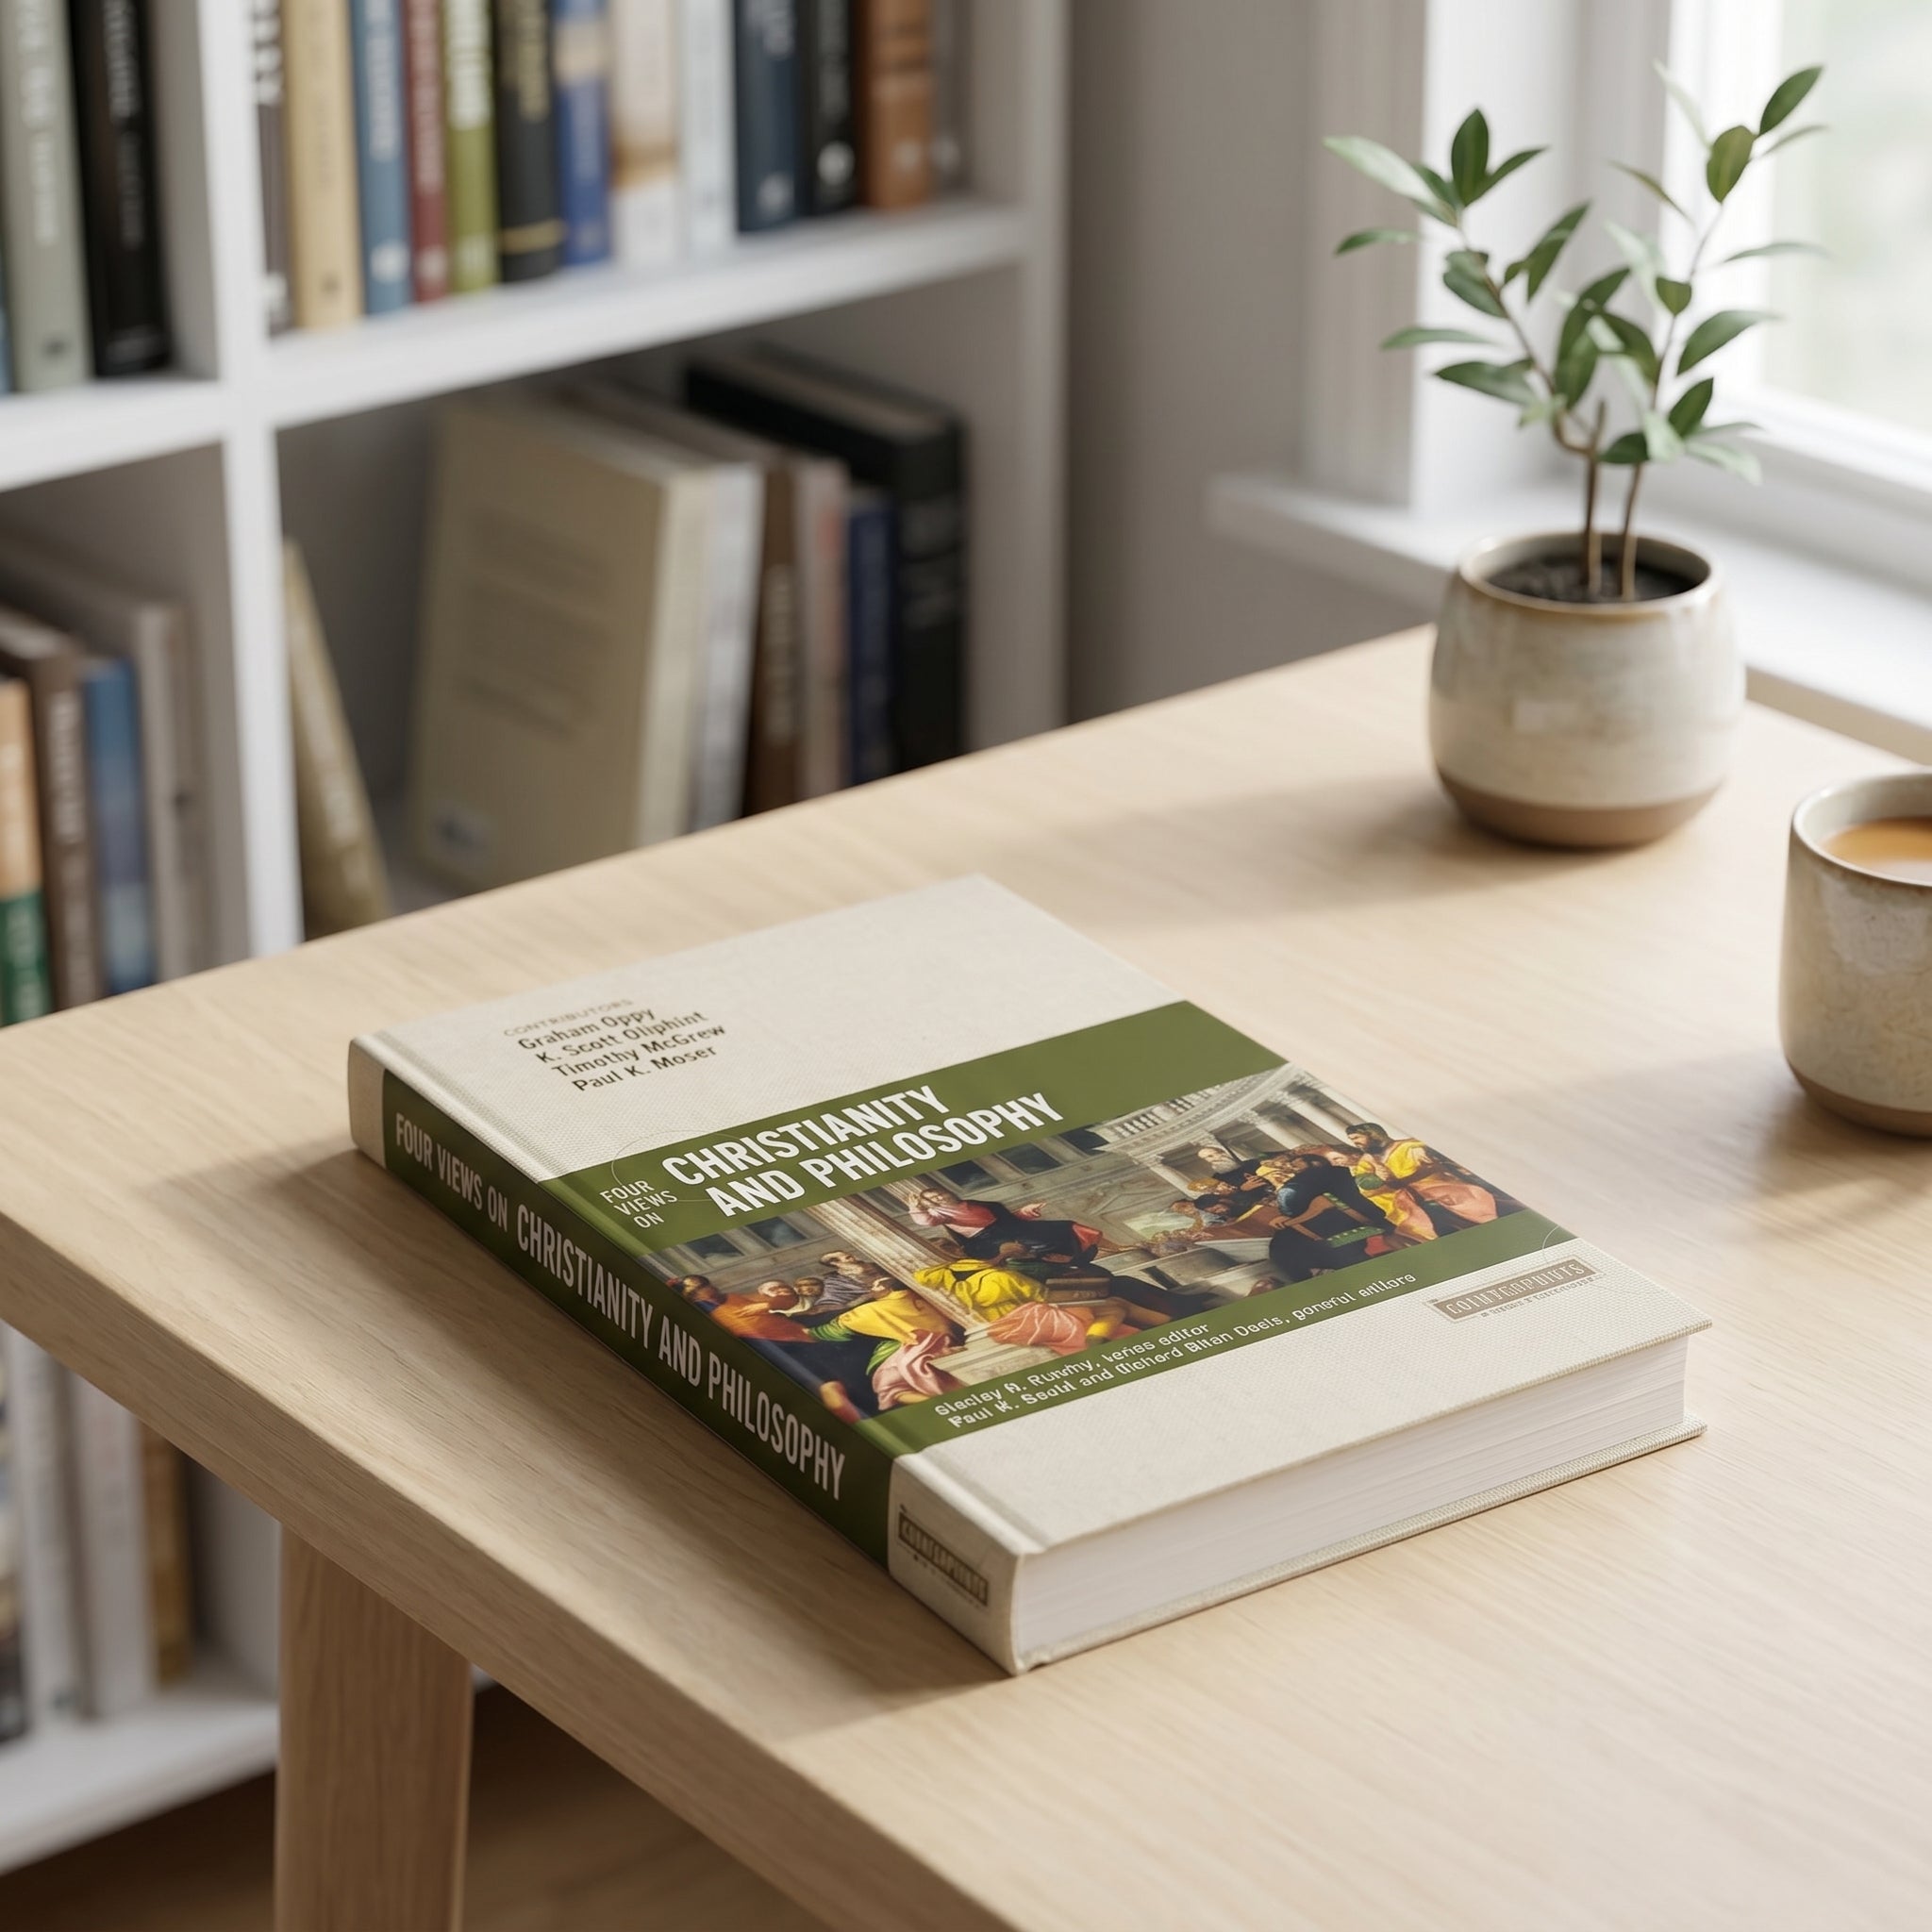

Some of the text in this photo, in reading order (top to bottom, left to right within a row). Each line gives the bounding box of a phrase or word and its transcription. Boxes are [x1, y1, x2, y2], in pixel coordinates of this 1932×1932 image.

[504, 999, 633, 1037] CONTRIBUTORS
[518, 1009, 655, 1050] Graham Oppy
[536, 1011, 708, 1063] K. Scott Oliphint
[551, 1025, 725, 1076] Timothy McGrew
[572, 1046, 716, 1091] Paul K. Moser
[661, 1085, 950, 1186] CHRISTIANITY
[705, 1092, 1064, 1217] AND PHILOSOPHY
[599, 1180, 655, 1204] FOUR
[613, 1191, 677, 1215] VIEWS
[633, 1212, 664, 1228] ON
[395, 1112, 845, 1501] FOUR VIEWS ON CHRISTIANITY AND PHILOSOPHY
[1079, 1368, 1114, 1387] and
